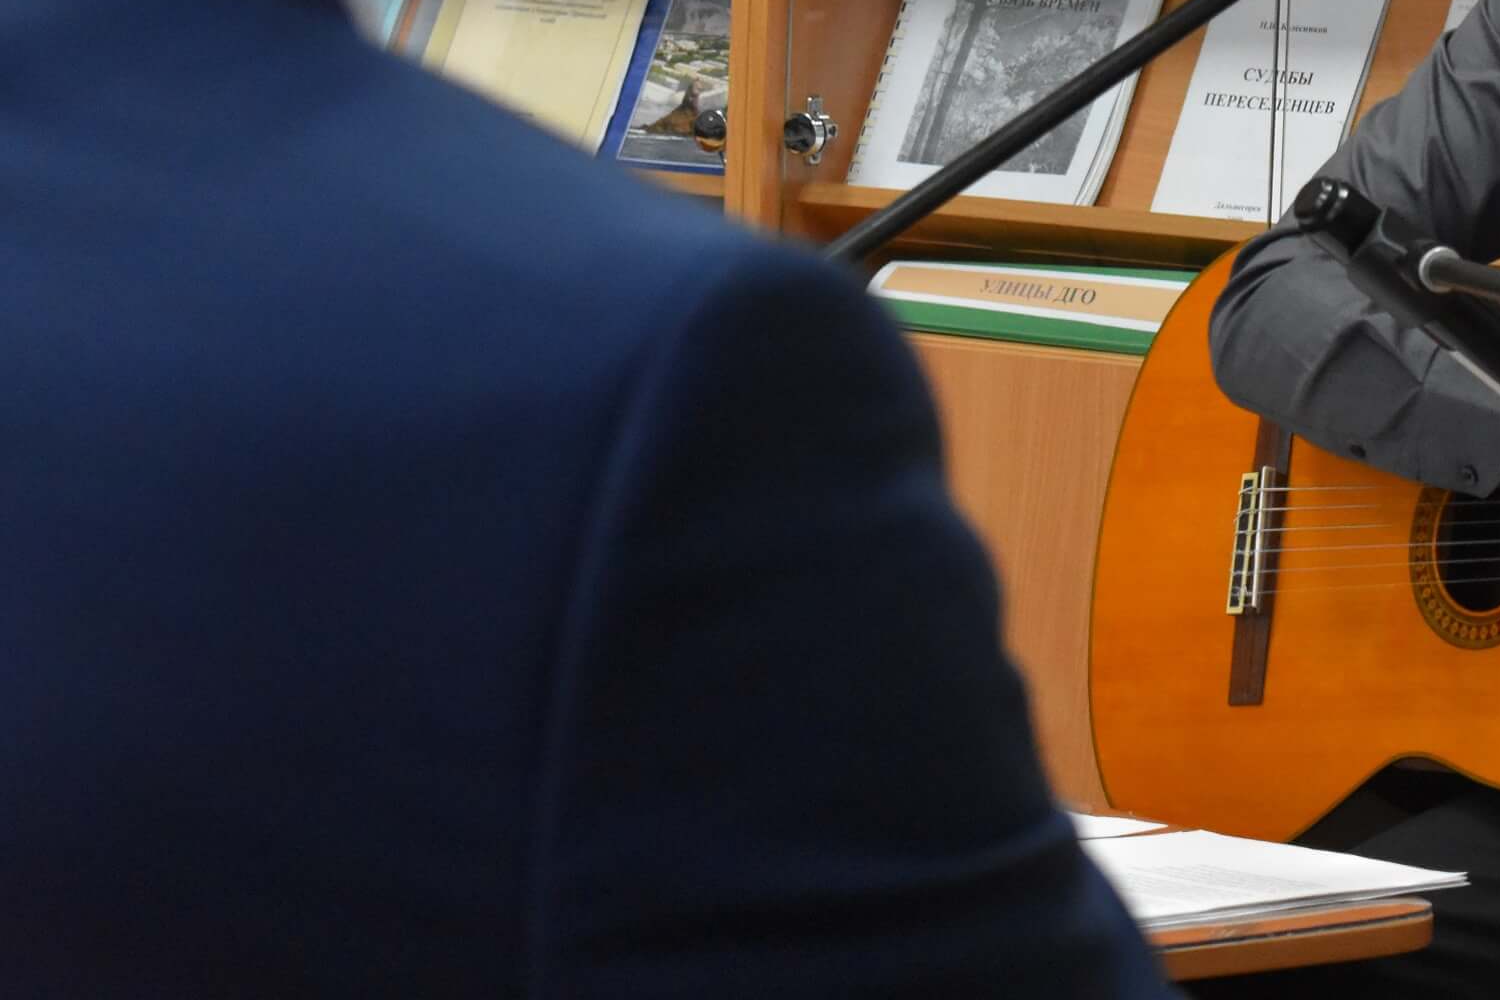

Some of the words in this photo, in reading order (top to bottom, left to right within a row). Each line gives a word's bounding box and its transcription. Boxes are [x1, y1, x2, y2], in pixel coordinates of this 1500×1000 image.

[1243, 67, 1314, 86] СУДЬБЫ
[1203, 92, 1336, 115] ПЕРЕСЕЛЕНЦЕВ
[980, 279, 1053, 300] УЛИЦЫ
[1052, 286, 1096, 305] ДГО
